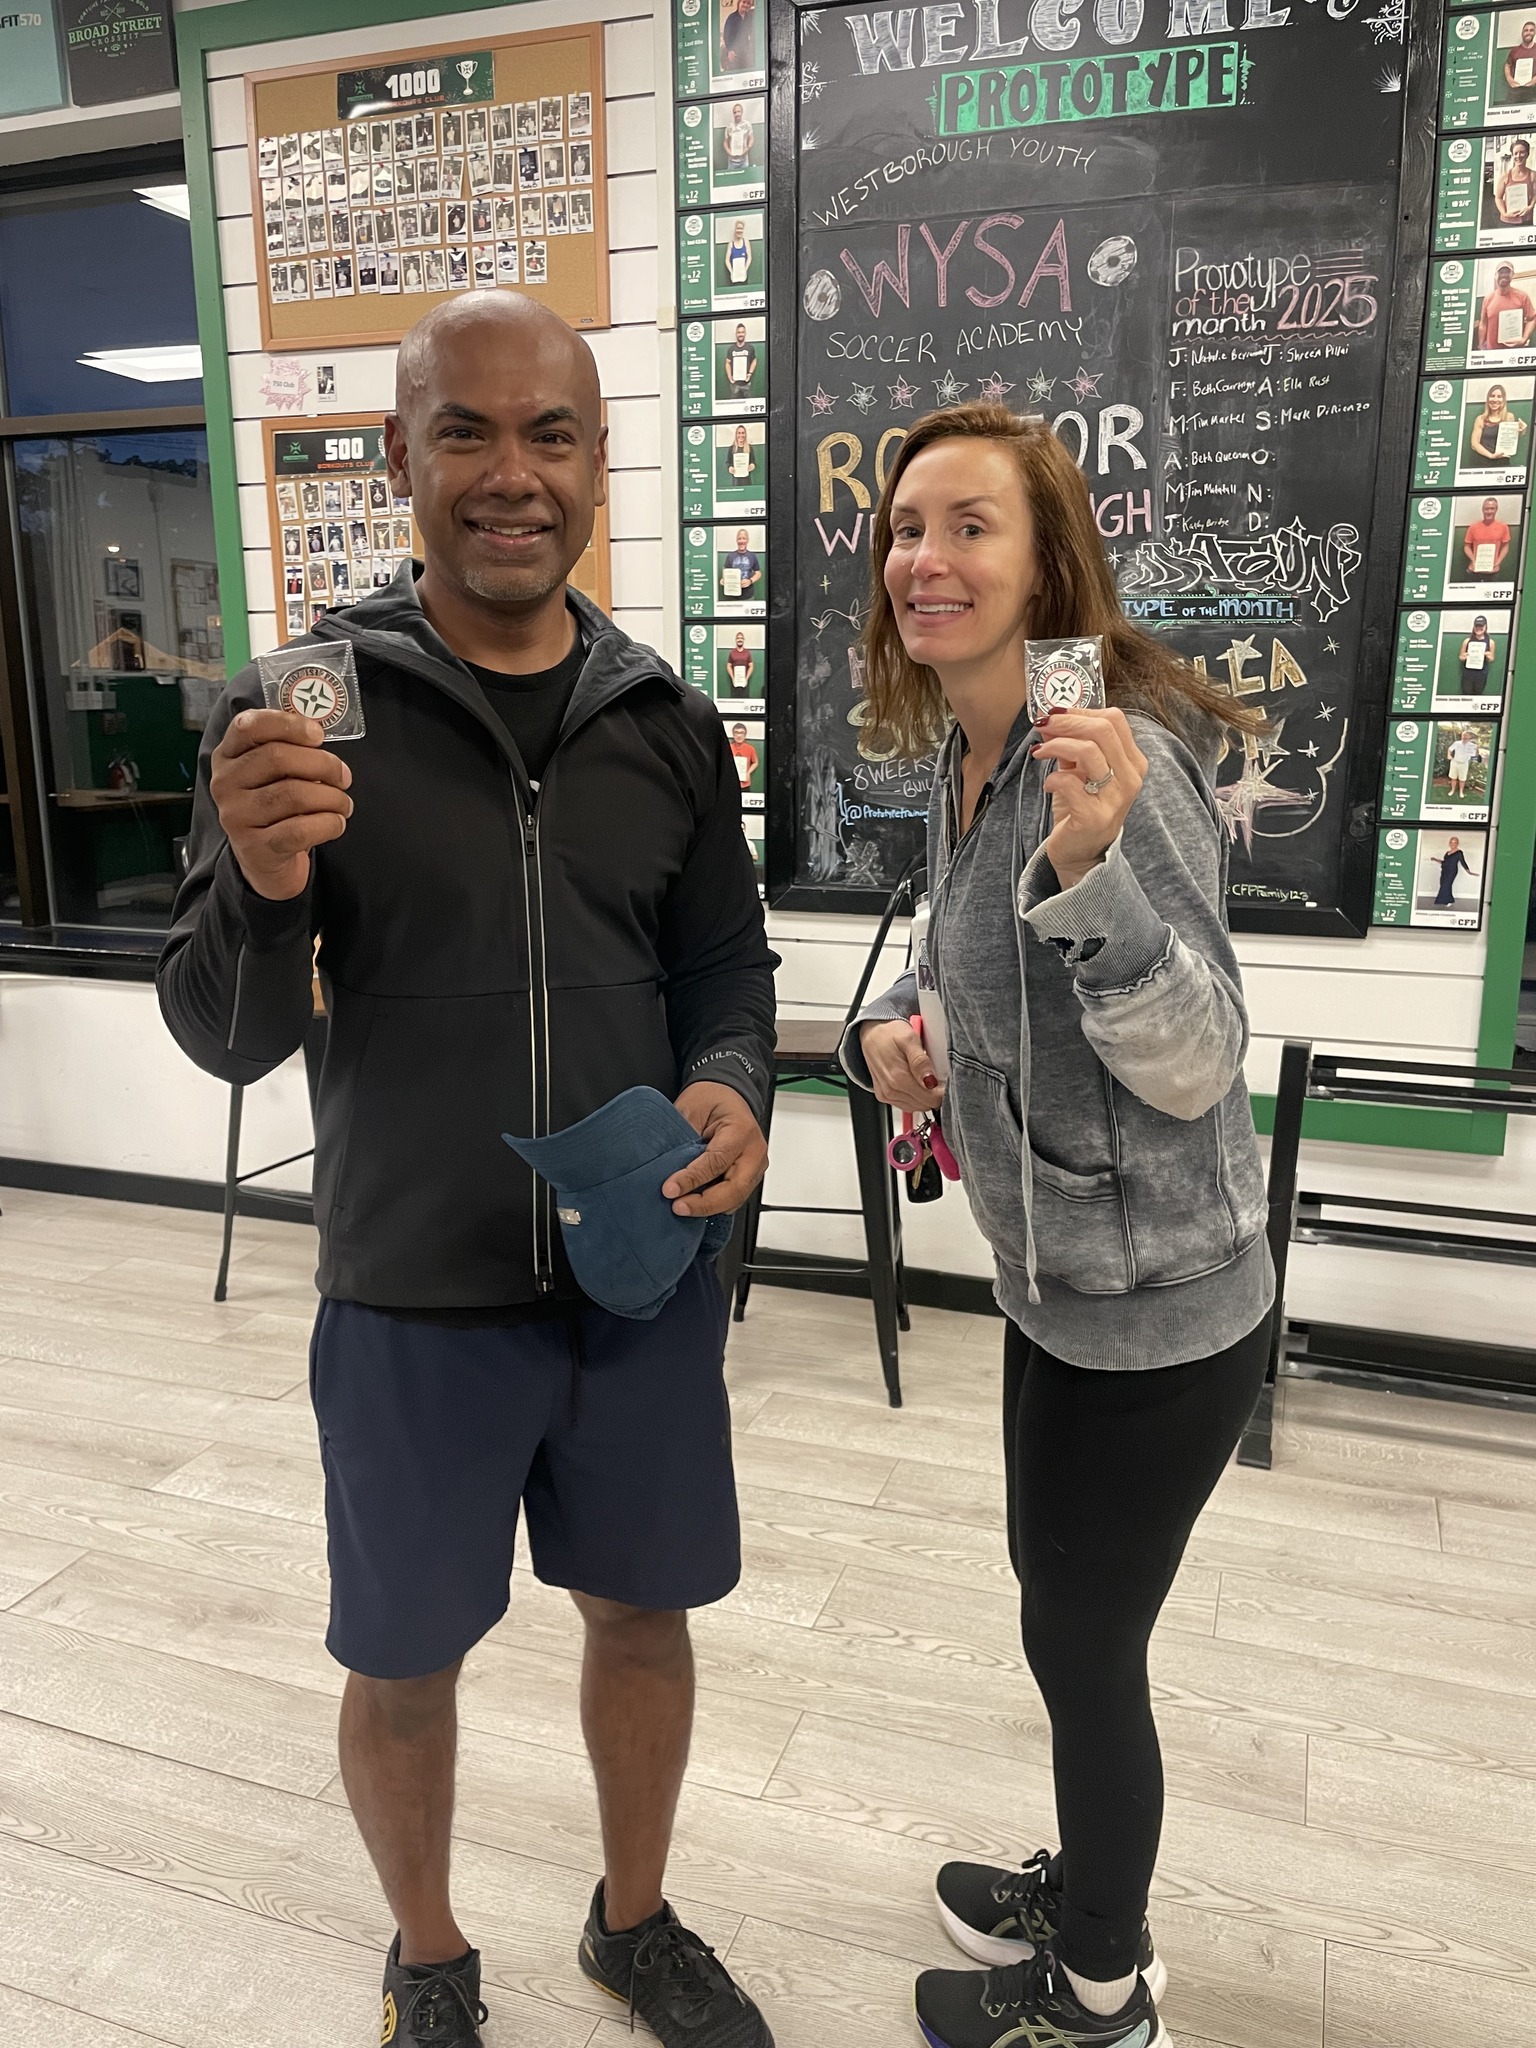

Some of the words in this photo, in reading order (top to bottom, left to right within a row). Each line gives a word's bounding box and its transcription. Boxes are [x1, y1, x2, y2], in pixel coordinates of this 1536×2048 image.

[0, 14, 41, 29] FIT570
[68, 24, 110, 44] BROAD
[113, 16, 162, 34] STREET
[91, 33, 139, 47] CROSSFIT
[385, 68, 441, 99] 1000
[749, 78, 764, 87] CFP
[943, 46, 1237, 133] PROTOTYPE
[424, 94, 445, 103] CLUB
[813, 135, 993, 226] WESTBOROUGH
[1010, 137, 1096, 173] YOUTH
[690, 190, 699, 198] 12
[840, 212, 1072, 318] WYSA
[692, 270, 701, 278] 12
[1175, 247, 1311, 312] Prototype
[1175, 288, 1206, 316] of
[1210, 290, 1250, 315] the
[1277, 275, 1379, 330] 2025
[1172, 315, 1266, 337] month
[826, 331, 937, 363] SOCCER
[956, 317, 1084, 356] ACADEMY
[1517, 356, 1536, 364] CFP
[1281, 407, 1310, 425] Mark
[325, 437, 364, 461] 500
[1429, 471, 1440, 479] 12
[1505, 475, 1525, 483] CFP
[1122, 600, 1177, 617] TYPE
[1182, 607, 1196, 617] OF
[1198, 606, 1218, 616] THE
[1406, 696, 1417, 704] 12
[867, 754, 937, 785] WEEKS
[894, 779, 932, 797] -BUIL
[1395, 804, 1406, 812] 12
[1386, 909, 1397, 917] 12
[1458, 918, 1477, 926] CFP
